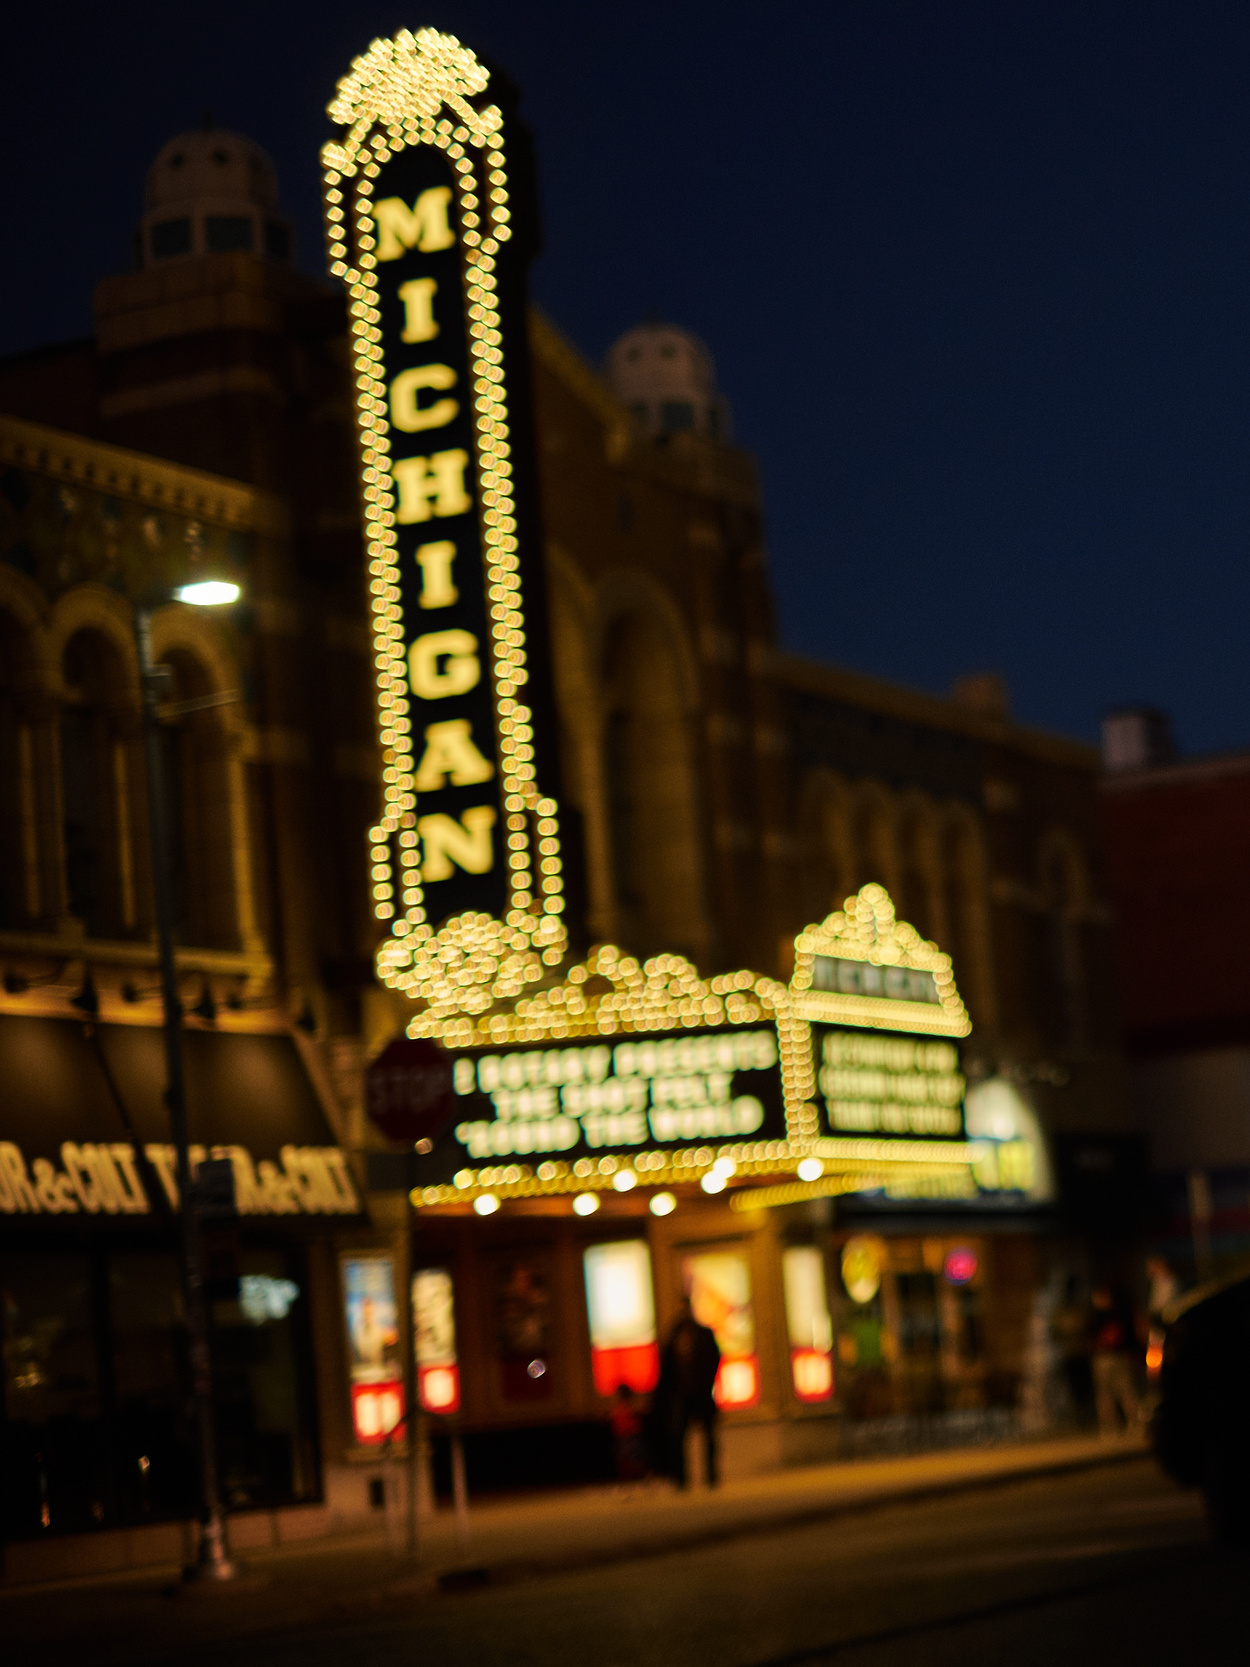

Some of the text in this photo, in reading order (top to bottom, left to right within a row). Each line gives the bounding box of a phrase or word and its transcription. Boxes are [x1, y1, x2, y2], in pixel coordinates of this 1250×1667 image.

[371, 186, 496, 882] MICHIGAN
[491, 1087, 560, 1124] THE
[580, 1110, 649, 1149] THE
